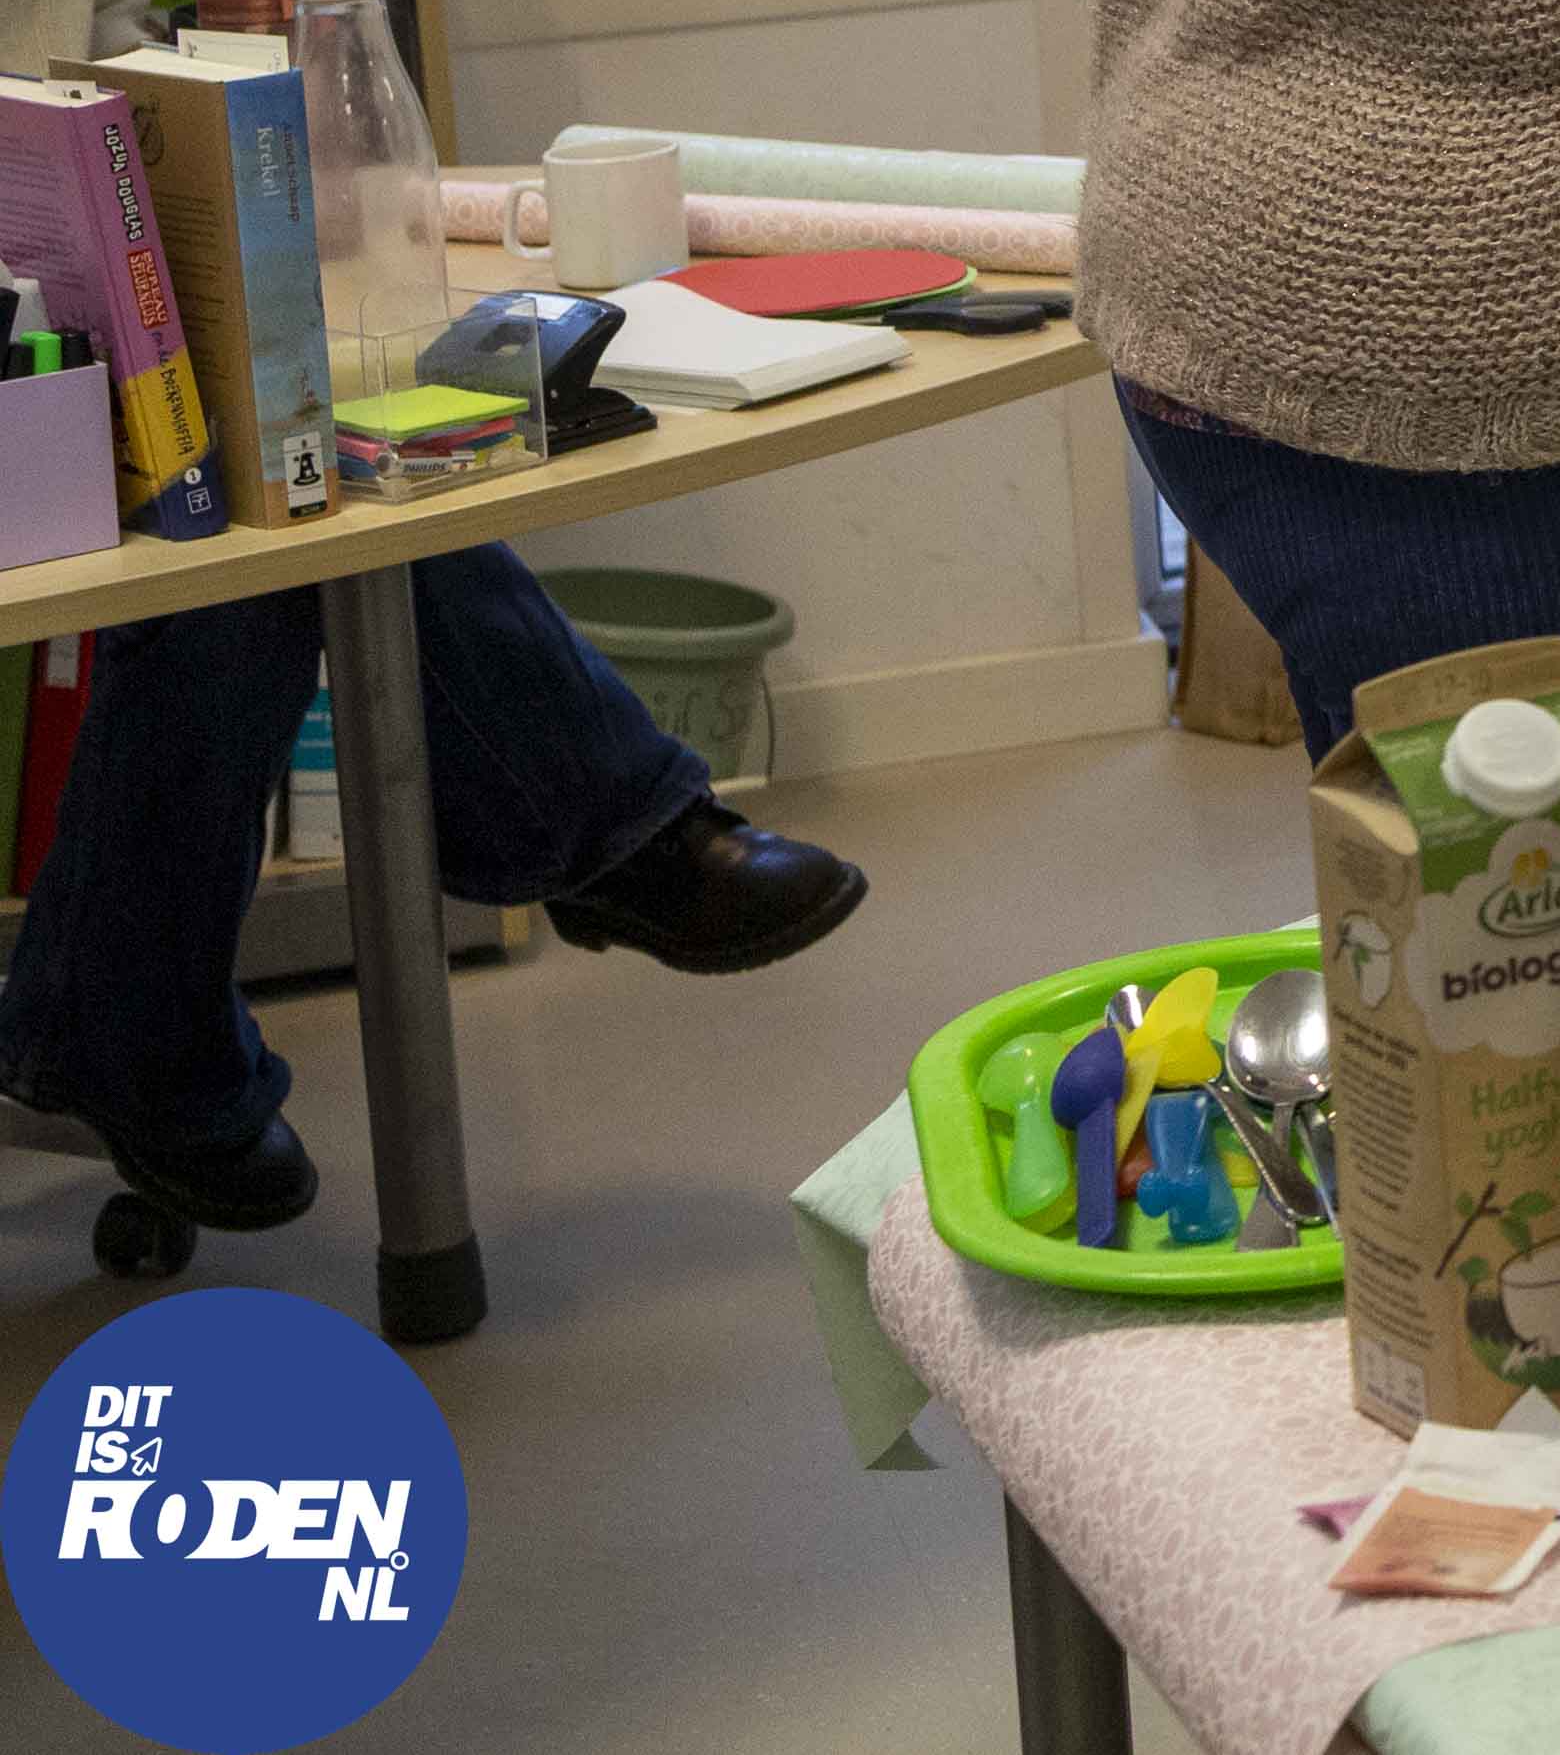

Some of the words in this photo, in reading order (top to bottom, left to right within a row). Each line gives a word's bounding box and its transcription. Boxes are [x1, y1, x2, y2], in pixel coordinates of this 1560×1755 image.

[104, 124, 128, 173] JOZUA
[117, 174, 144, 243] DOUGLAS
[257, 127, 280, 197] Krekel
